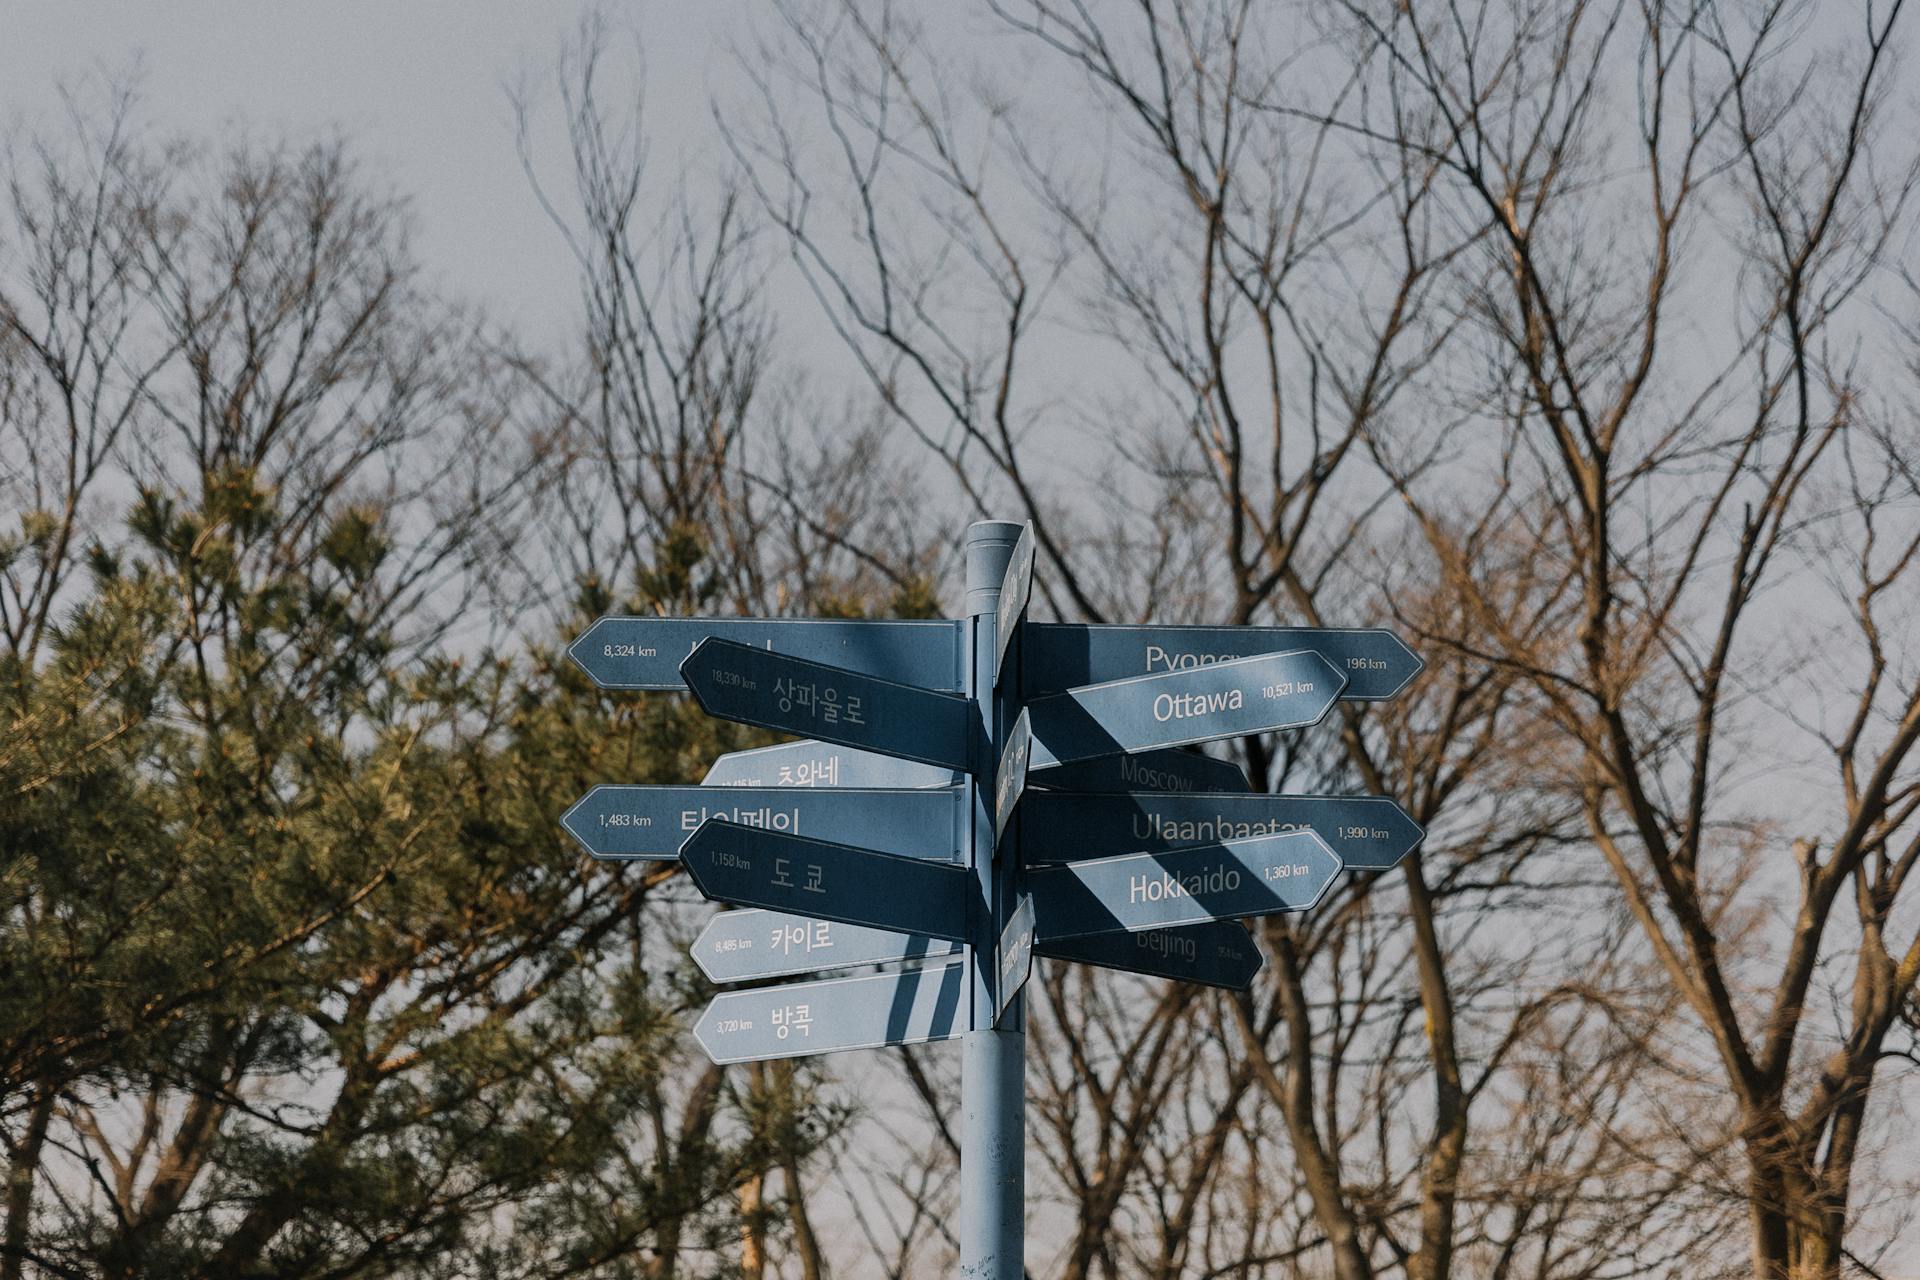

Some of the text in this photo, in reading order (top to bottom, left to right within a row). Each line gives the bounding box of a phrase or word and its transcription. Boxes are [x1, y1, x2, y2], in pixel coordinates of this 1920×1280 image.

[603, 645, 657, 658] 8,324 km
[1345, 657, 1366, 670] 196
[1367, 657, 1387, 670] km
[742, 676, 756, 690] km
[773, 678, 866, 725] 상파울로
[1153, 680, 1314, 722] Ottawa 10,521 km
[1121, 755, 1193, 792] Moscow
[599, 814, 630, 828] 1,483
[633, 814, 652, 827] km
[1337, 825, 1368, 841] 1,990
[1370, 825, 1389, 840] km
[711, 850, 735, 867] 1,158
[736, 855, 751, 870] km
[1130, 862, 1310, 904] Hokkaido 1,360 km
[738, 938, 752, 949] km
[771, 920, 835, 956] 카이로
[1136, 928, 1196, 963] Beijing
[740, 1018, 753, 1031] km
[771, 1004, 814, 1040] 방콕
